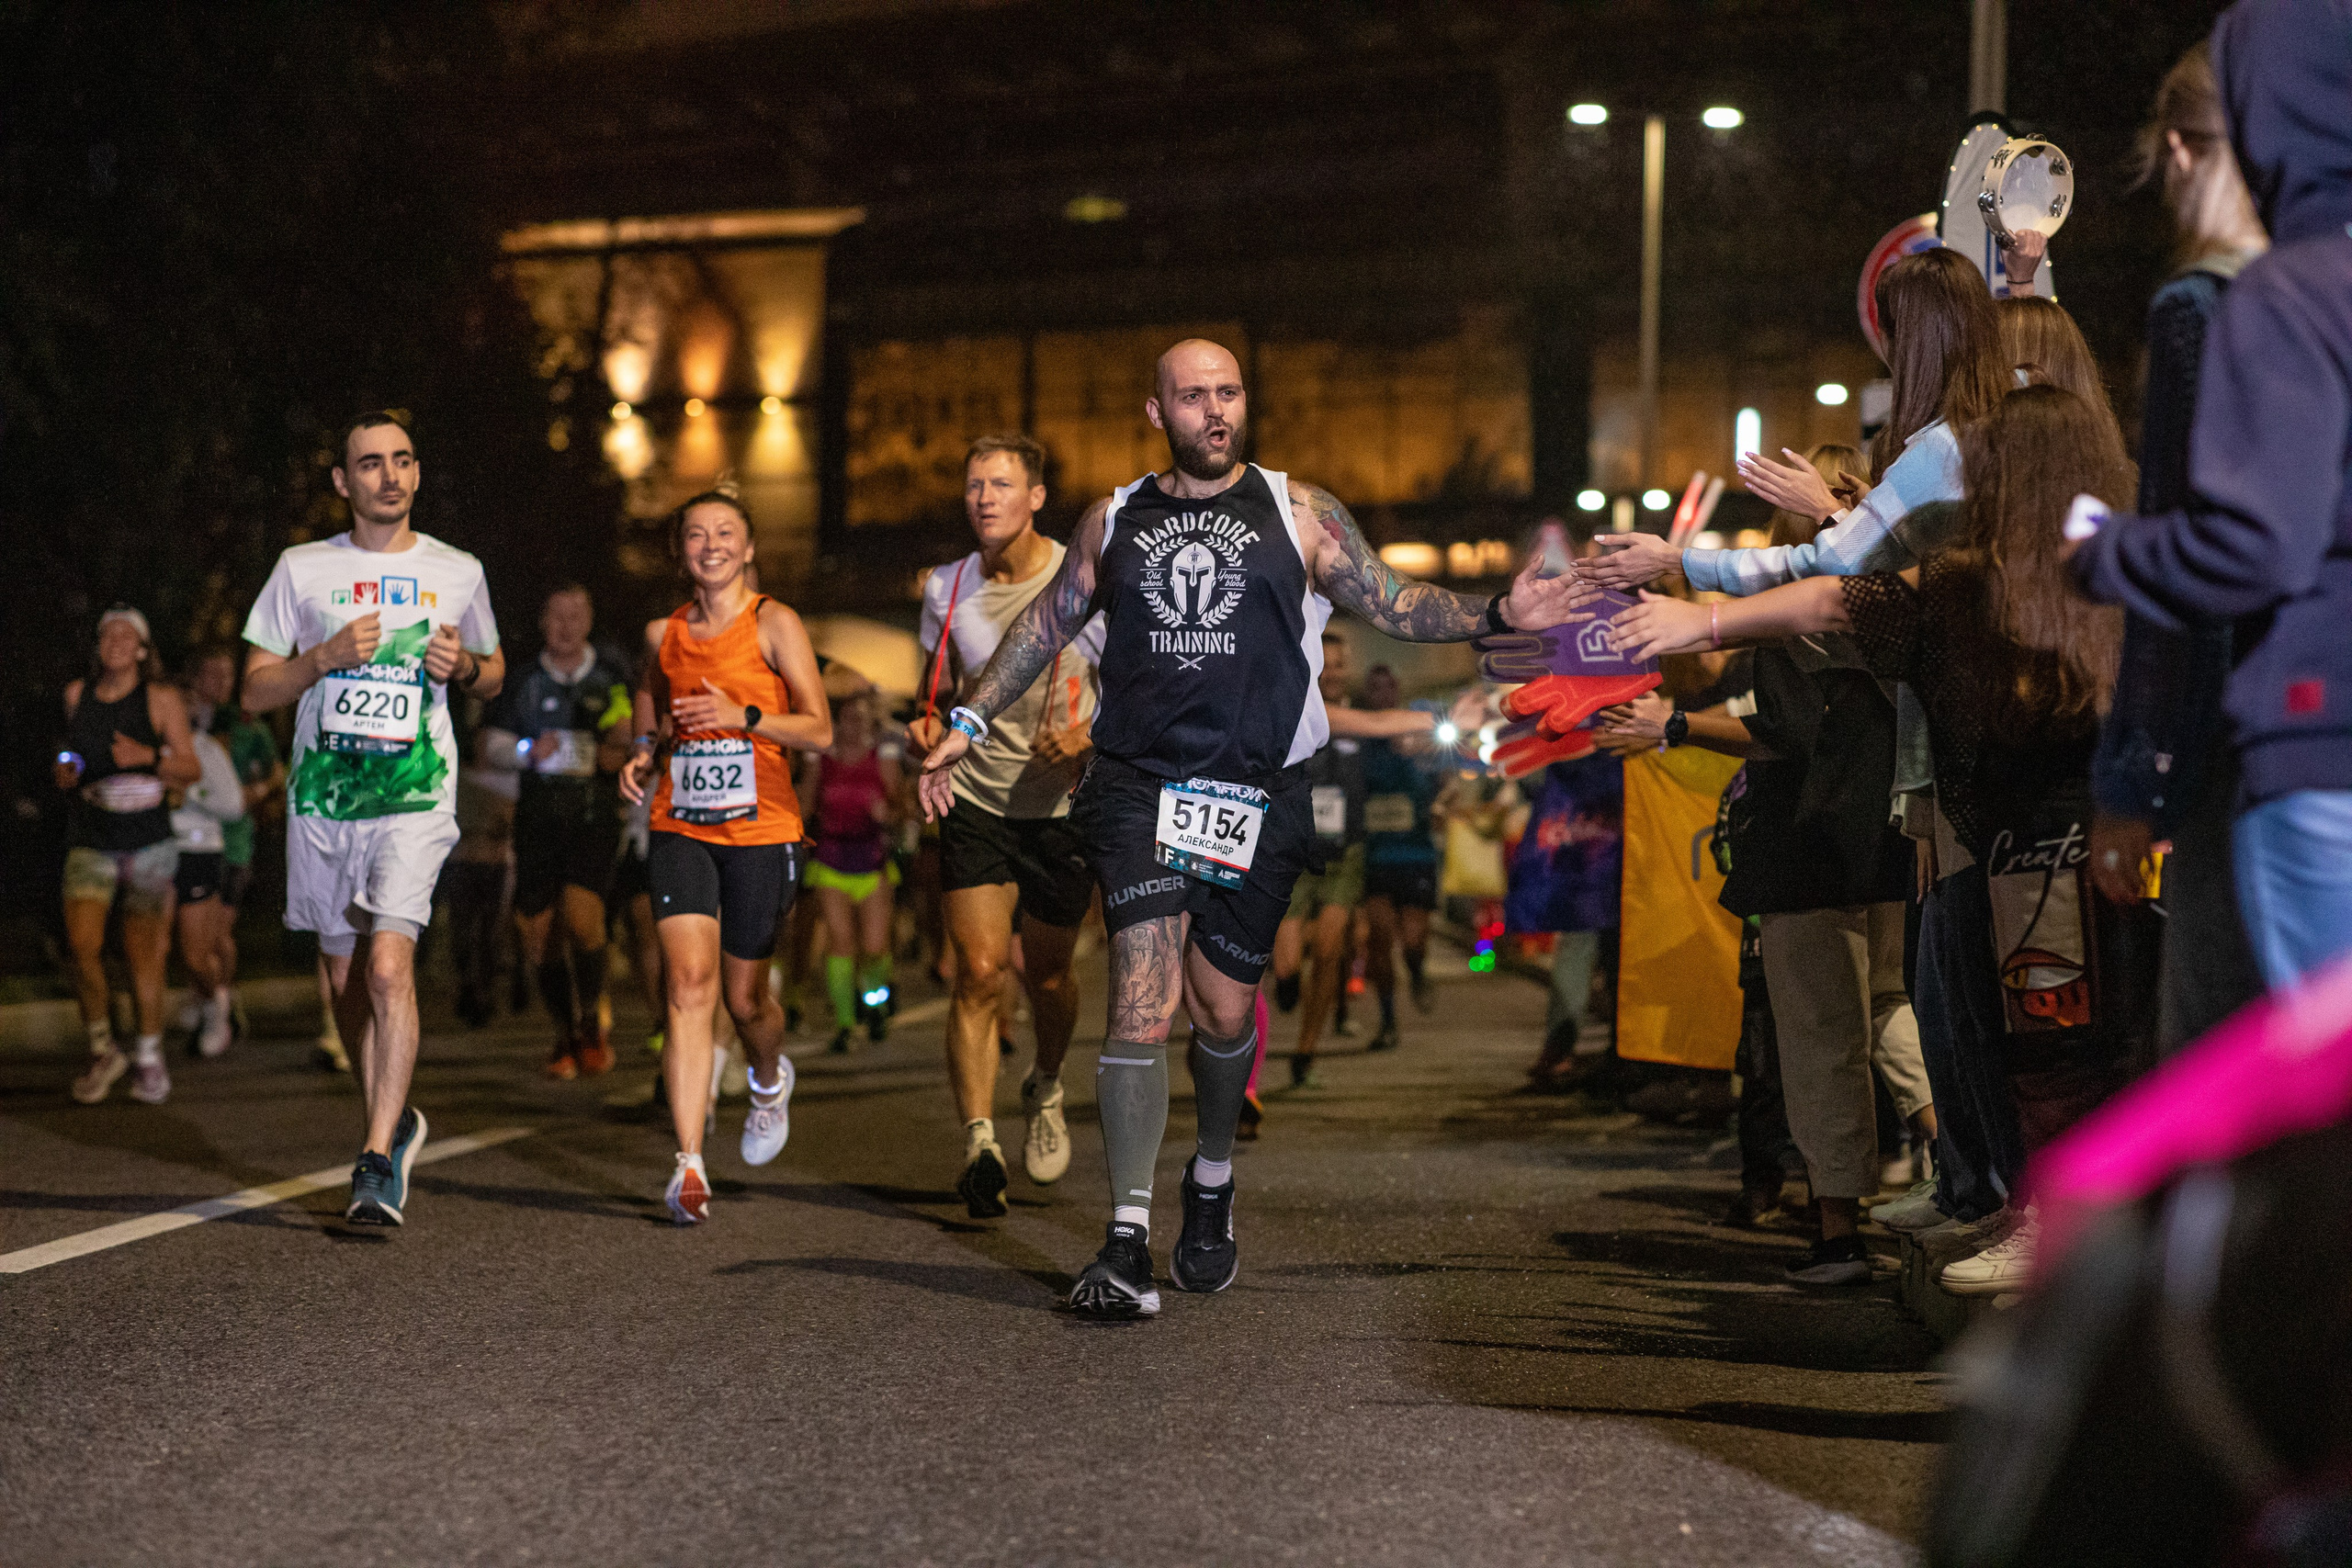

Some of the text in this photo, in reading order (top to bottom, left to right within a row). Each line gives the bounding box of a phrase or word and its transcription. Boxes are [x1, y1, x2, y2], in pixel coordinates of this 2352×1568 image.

[1133, 511, 1261, 552] HARDCORE
[1139, 579, 1163, 588] school
[1146, 571, 1161, 580] Old
[1217, 570, 1241, 582] Young
[1148, 631, 1236, 655] TRAINING
[334, 688, 409, 720] 6220
[682, 763, 742, 792] 6632
[1171, 798, 1250, 847] 5154
[1164, 847, 1175, 864] F
[1177, 833, 1235, 857] АЛЕКСАНДР
[1987, 822, 2090, 876] Create
[1113, 875, 1186, 906] UNDER
[1114, 1226, 1135, 1235] HOKA
